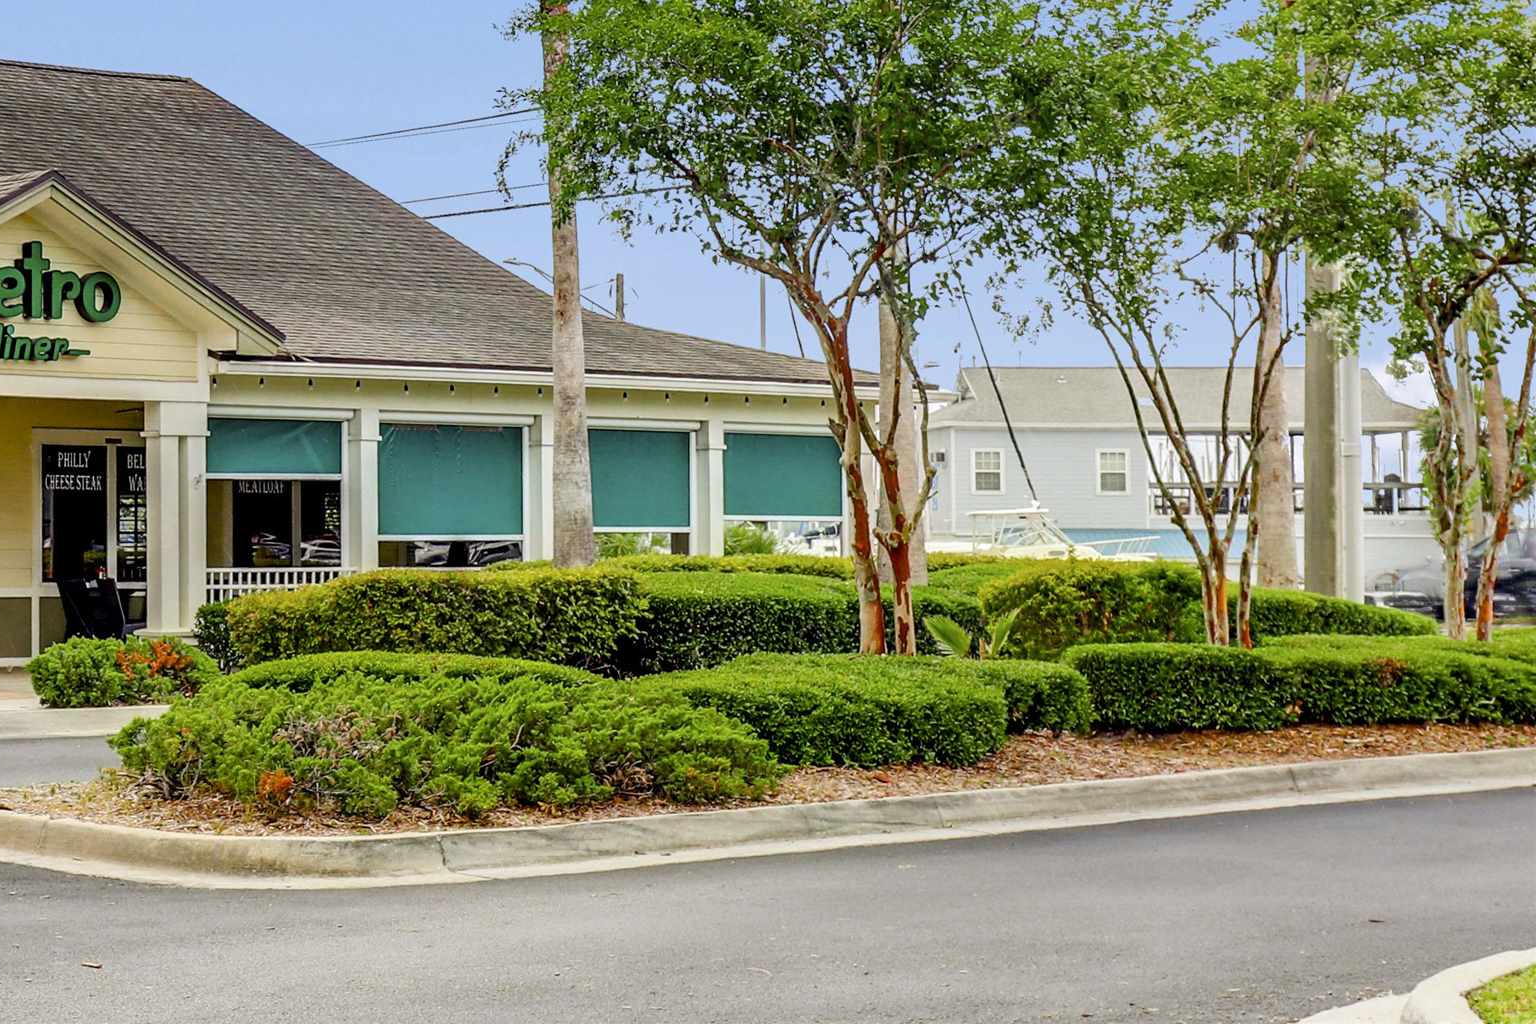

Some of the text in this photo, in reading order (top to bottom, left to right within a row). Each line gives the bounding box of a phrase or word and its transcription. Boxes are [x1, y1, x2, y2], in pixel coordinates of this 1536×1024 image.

[57, 450, 91, 469] PHILLY
[45, 474, 102, 491] CHEESE STEAK
